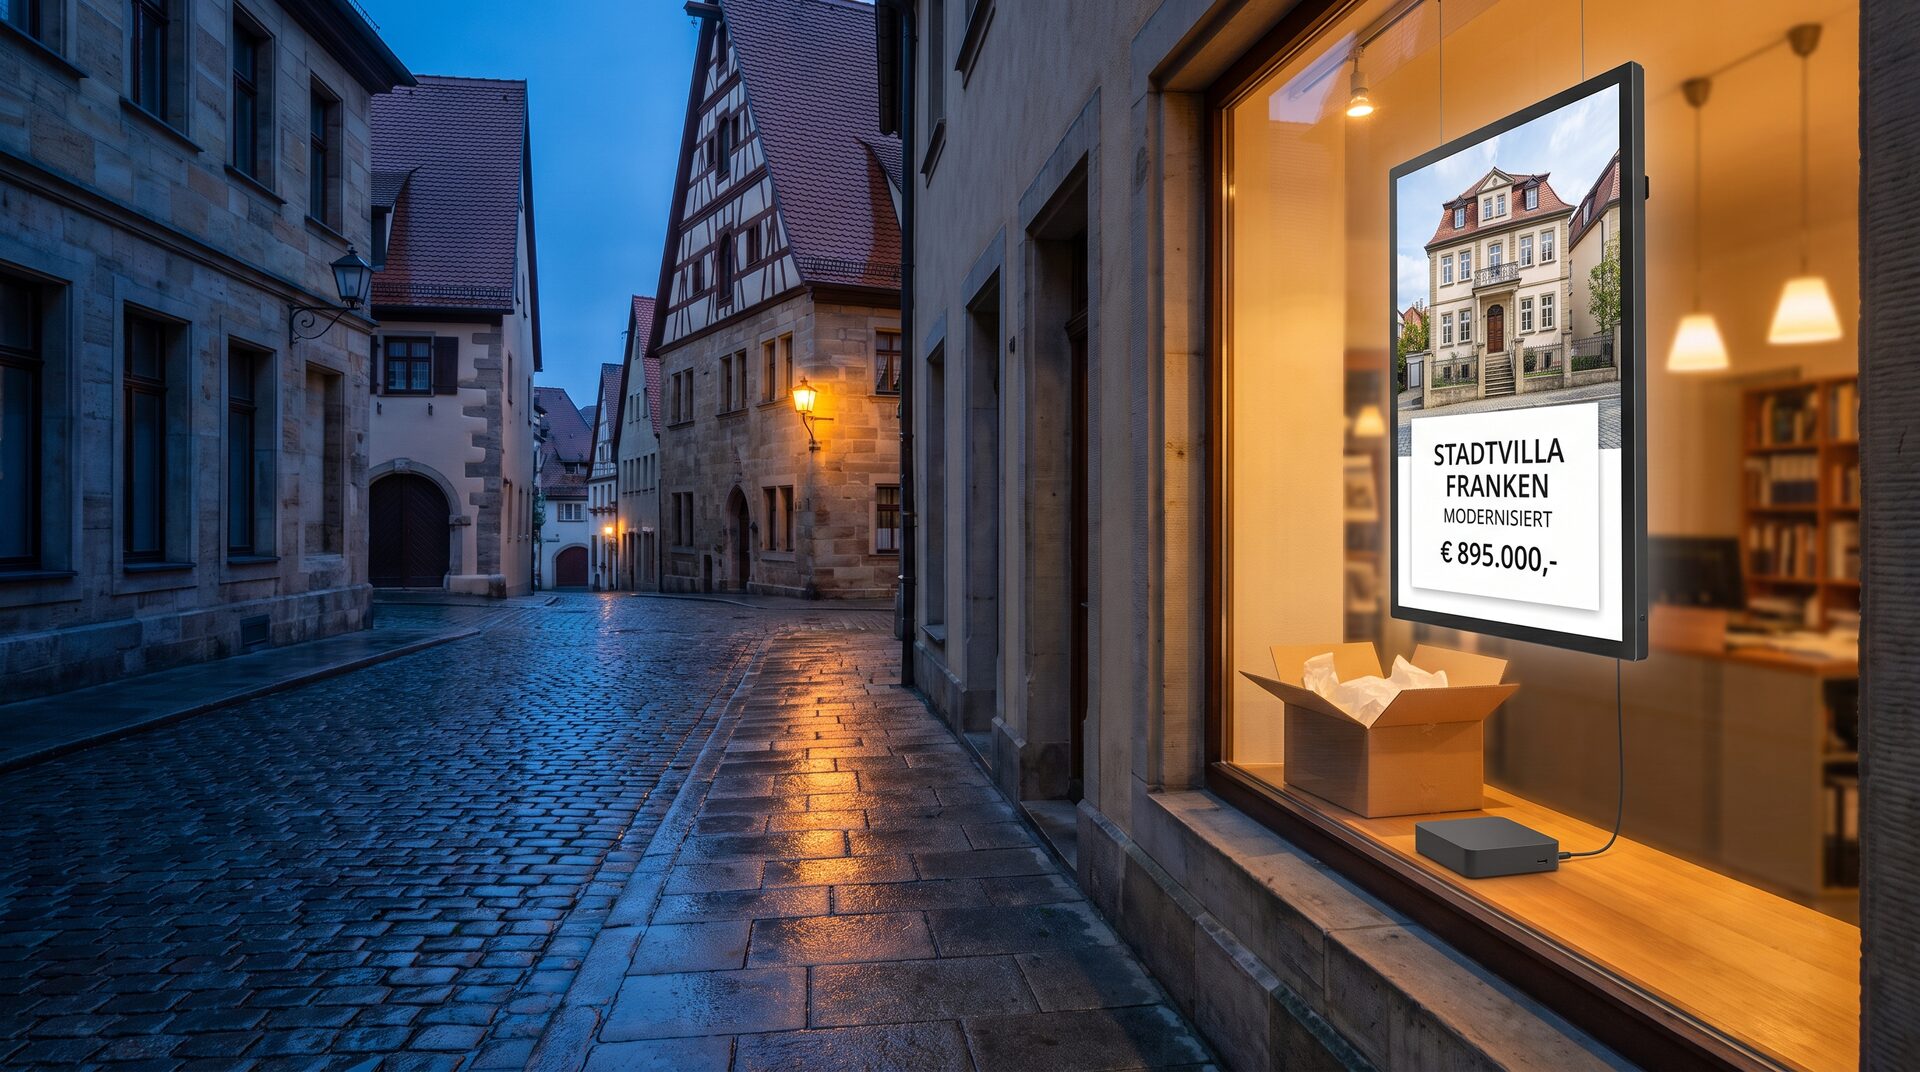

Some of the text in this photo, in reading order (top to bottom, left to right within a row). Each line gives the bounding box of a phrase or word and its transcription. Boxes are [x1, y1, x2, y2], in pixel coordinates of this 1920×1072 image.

[1434, 438, 1565, 466] STADTVILLA
[1446, 473, 1548, 498] FRANKEN
[1443, 508, 1553, 528] MODERNISIERT
[1440, 540, 1558, 577] € 895.000,-
